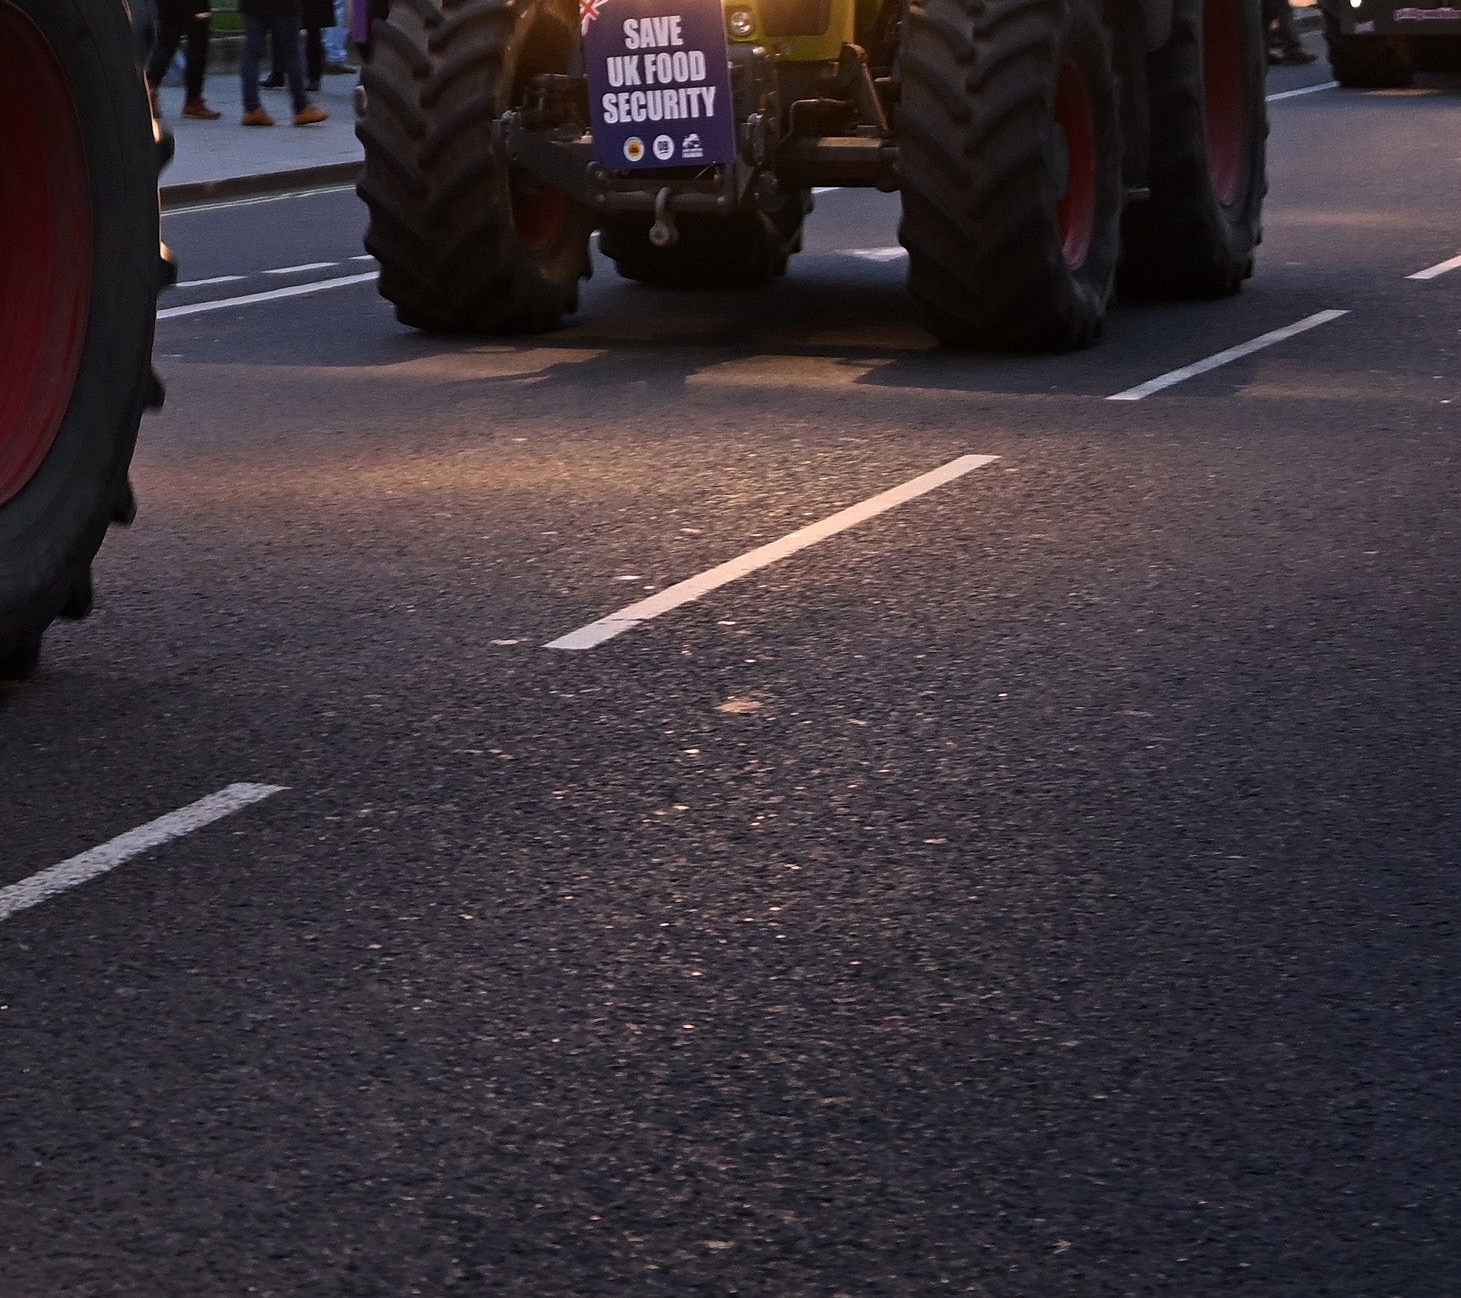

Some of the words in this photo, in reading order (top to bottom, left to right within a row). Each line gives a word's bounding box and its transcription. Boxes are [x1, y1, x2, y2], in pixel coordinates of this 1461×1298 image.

[623, 15, 684, 49] SAVE
[606, 54, 641, 87] UK
[643, 50, 707, 84] FOOD
[602, 86, 716, 124] SECURITY
